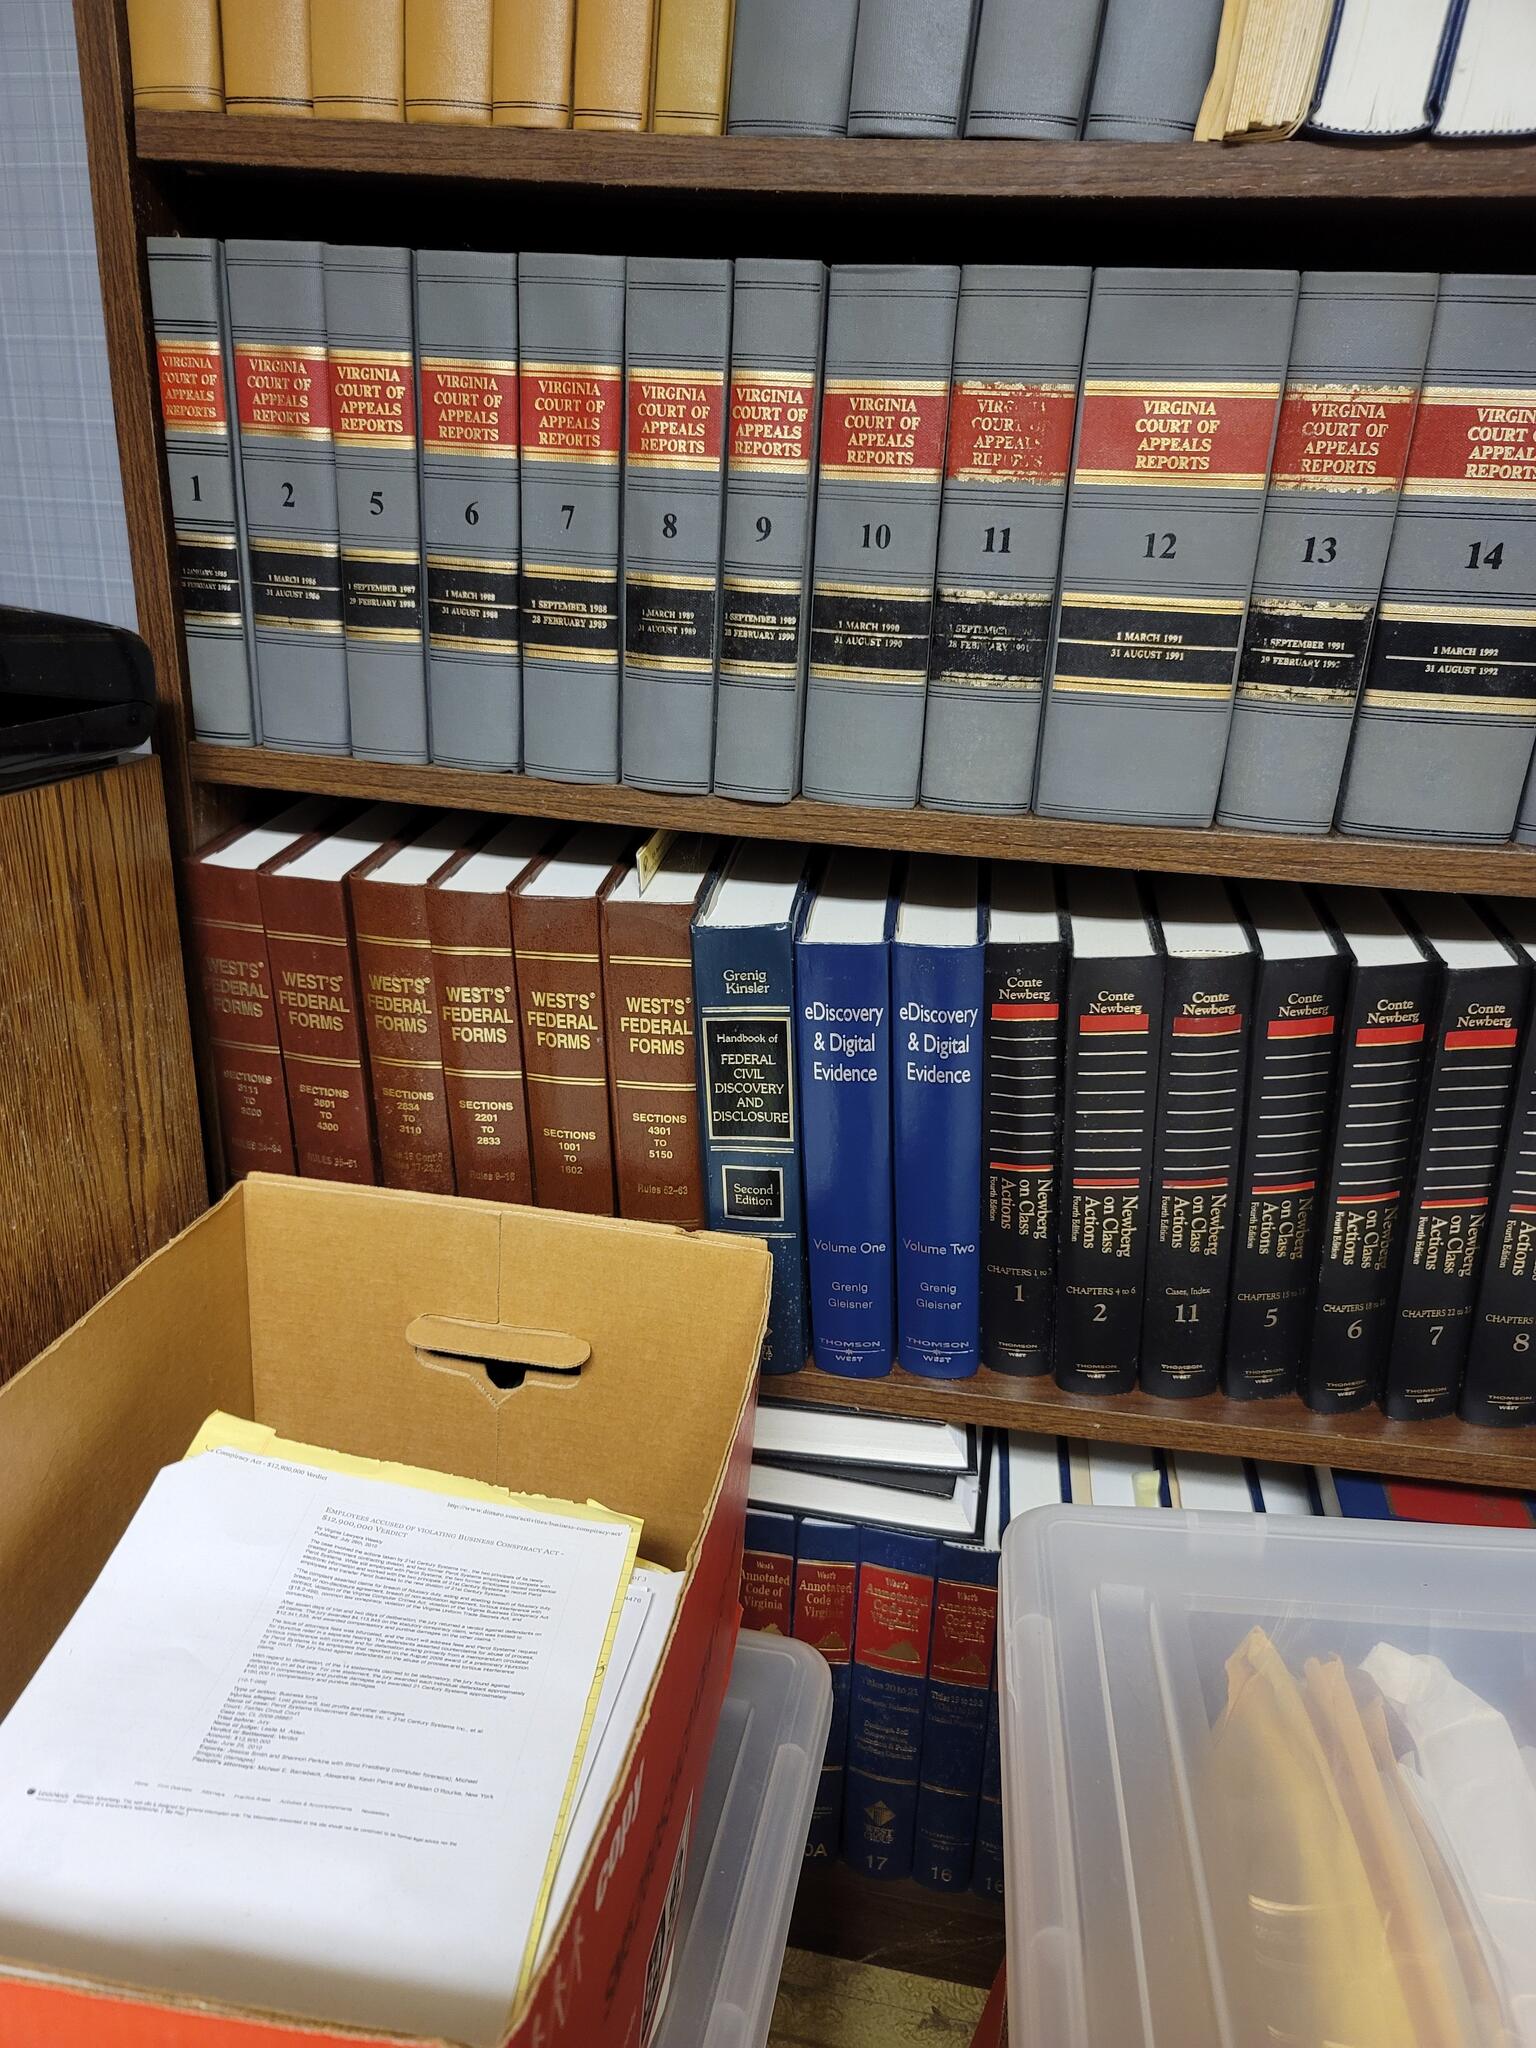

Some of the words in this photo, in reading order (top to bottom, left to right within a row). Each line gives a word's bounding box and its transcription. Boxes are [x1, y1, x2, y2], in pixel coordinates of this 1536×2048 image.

[337, 366, 400, 382] VIRGINIA
[335, 384, 381, 398] COURT
[386, 386, 405, 399] OF
[736, 388, 804, 404] VIRGINIA
[340, 401, 402, 416] APPEALS
[733, 406, 782, 421] COURT
[787, 409, 808, 422] OF
[1143, 400, 1217, 415] VIRGINIA
[1311, 404, 1386, 419] VIRGINIA
[341, 418, 403, 432] REPORTS
[736, 424, 802, 439] APPEALS
[1135, 420, 1190, 434] COURT
[1197, 420, 1220, 434] OF
[1302, 423, 1359, 437] COURT
[1366, 424, 1389, 437] OF
[735, 442, 801, 457] REPORTS
[1138, 438, 1212, 452] APPEALS
[1304, 442, 1380, 456] APPEALS
[1135, 456, 1210, 471] REPORTS
[1301, 459, 1376, 475] REPORTS
[191, 476, 202, 502] 1
[281, 482, 295, 508] 2
[370, 492, 383, 515] 5
[465, 501, 479, 525] 6
[561, 505, 575, 529] 7
[662, 513, 677, 538] 8
[756, 516, 772, 542] 9
[862, 524, 891, 549] 10
[982, 527, 1011, 554] 11
[1143, 532, 1177, 559] 12
[1301, 536, 1337, 563] 13
[1464, 541, 1504, 570] 14
[531, 600, 536, 609] 1
[538, 601, 587, 613] SEPTEMBER
[589, 604, 607, 614] 1988
[543, 617, 586, 628] FEBRUARY
[588, 620, 607, 629] 1989
[1116, 632, 1121, 641] 1
[1125, 632, 1161, 642] MARCH
[1164, 634, 1183, 643] 1991
[1111, 649, 1121, 658] 31
[1123, 650, 1161, 660] AUGUST
[1165, 651, 1184, 661] 1991
[1433, 646, 1438, 654] 1
[1441, 646, 1476, 656] MARCH
[1480, 648, 1498, 656] 1992
[1425, 664, 1435, 672] 31
[1438, 665, 1476, 675] AUGUST
[1479, 667, 1498, 675] 1992
[723, 970, 767, 982] Grenig
[1007, 977, 1043, 988] Conte
[726, 982, 769, 994] Kinsler
[999, 989, 1051, 1001] Newberg
[1098, 991, 1134, 1002] Conte
[1192, 992, 1229, 1003] Conte
[1288, 993, 1323, 1005] Conte
[1089, 1003, 1143, 1014] Newberg
[1183, 1003, 1236, 1015] Newberg
[1278, 1005, 1329, 1018] Newberg
[1377, 999, 1414, 1011] Conte
[1468, 1004, 1505, 1014] Conte
[442, 1007, 514, 1024] FEDERAL
[528, 1011, 598, 1030] FEDERAL
[805, 1002, 883, 1026] eDiscovery
[900, 1002, 978, 1028] eDiscovery
[1367, 1011, 1420, 1024] Newberg
[620, 1017, 693, 1035] FEDERAL
[1457, 1016, 1512, 1028] Newberg
[452, 1027, 507, 1043] FORMS
[537, 1032, 591, 1050] FORMS
[716, 1034, 765, 1043] Handbook
[769, 1034, 778, 1043] of
[630, 1038, 685, 1055] FORMS
[814, 1032, 825, 1051] &
[830, 1033, 875, 1057] Digital
[908, 1032, 919, 1051] &
[924, 1034, 969, 1059] Digital
[721, 1054, 776, 1065] FEDERAL
[734, 1069, 765, 1079] CIVIL
[814, 1062, 877, 1081] Evidence
[907, 1062, 971, 1083] Evidence
[715, 1083, 784, 1094] DISCOVERY
[459, 1100, 514, 1111] SECTIONS
[737, 1097, 764, 1108] AND
[474, 1114, 498, 1122] 2201
[632, 1113, 687, 1124] SECTIONS
[713, 1111, 789, 1123] DISCLOSURE
[543, 1128, 596, 1140] SECTIONS
[648, 1127, 671, 1136] 4301
[477, 1137, 501, 1145] 2833
[558, 1142, 581, 1151] 1001
[654, 1139, 666, 1147] TO
[649, 1151, 673, 1159] 5150
[561, 1165, 583, 1174] 1602
[734, 1183, 773, 1195] Second
[735, 1194, 773, 1206] Edition
[1103, 1196, 1113, 1213] on
[1072, 1196, 1081, 1221] Fourth
[1083, 1196, 1100, 1249] Actions
[1116, 1195, 1138, 1257] Newberg
[1101, 1217, 1119, 1254] Class
[813, 1239, 857, 1254] Volume
[861, 1243, 886, 1253] One
[903, 1238, 946, 1255] Volume
[950, 1243, 975, 1255] Two
[831, 1282, 868, 1294] Grenig
[920, 1282, 957, 1295] Grenig
[1014, 1285, 1024, 1302] 1
[1066, 1286, 1113, 1295] CHAPTERS
[828, 1299, 872, 1309] Gleisner
[916, 1299, 962, 1310] Gleisner
[1093, 1304, 1107, 1322] 2
[1175, 1304, 1199, 1322] 11
[1264, 1308, 1278, 1327] 5
[1347, 1320, 1362, 1339] 6
[1429, 1326, 1444, 1346] 7
[819, 1337, 880, 1348] THOMSON
[906, 1337, 969, 1348] THOMSON
[1513, 1333, 1530, 1352] 8
[756, 1561, 774, 1570] West's
[746, 1584, 770, 1596] Code
[772, 1588, 783, 1598] of
[744, 1597, 783, 1610] Virginia
[866, 1855, 888, 1871] 17
[931, 1867, 952, 1882] 16
